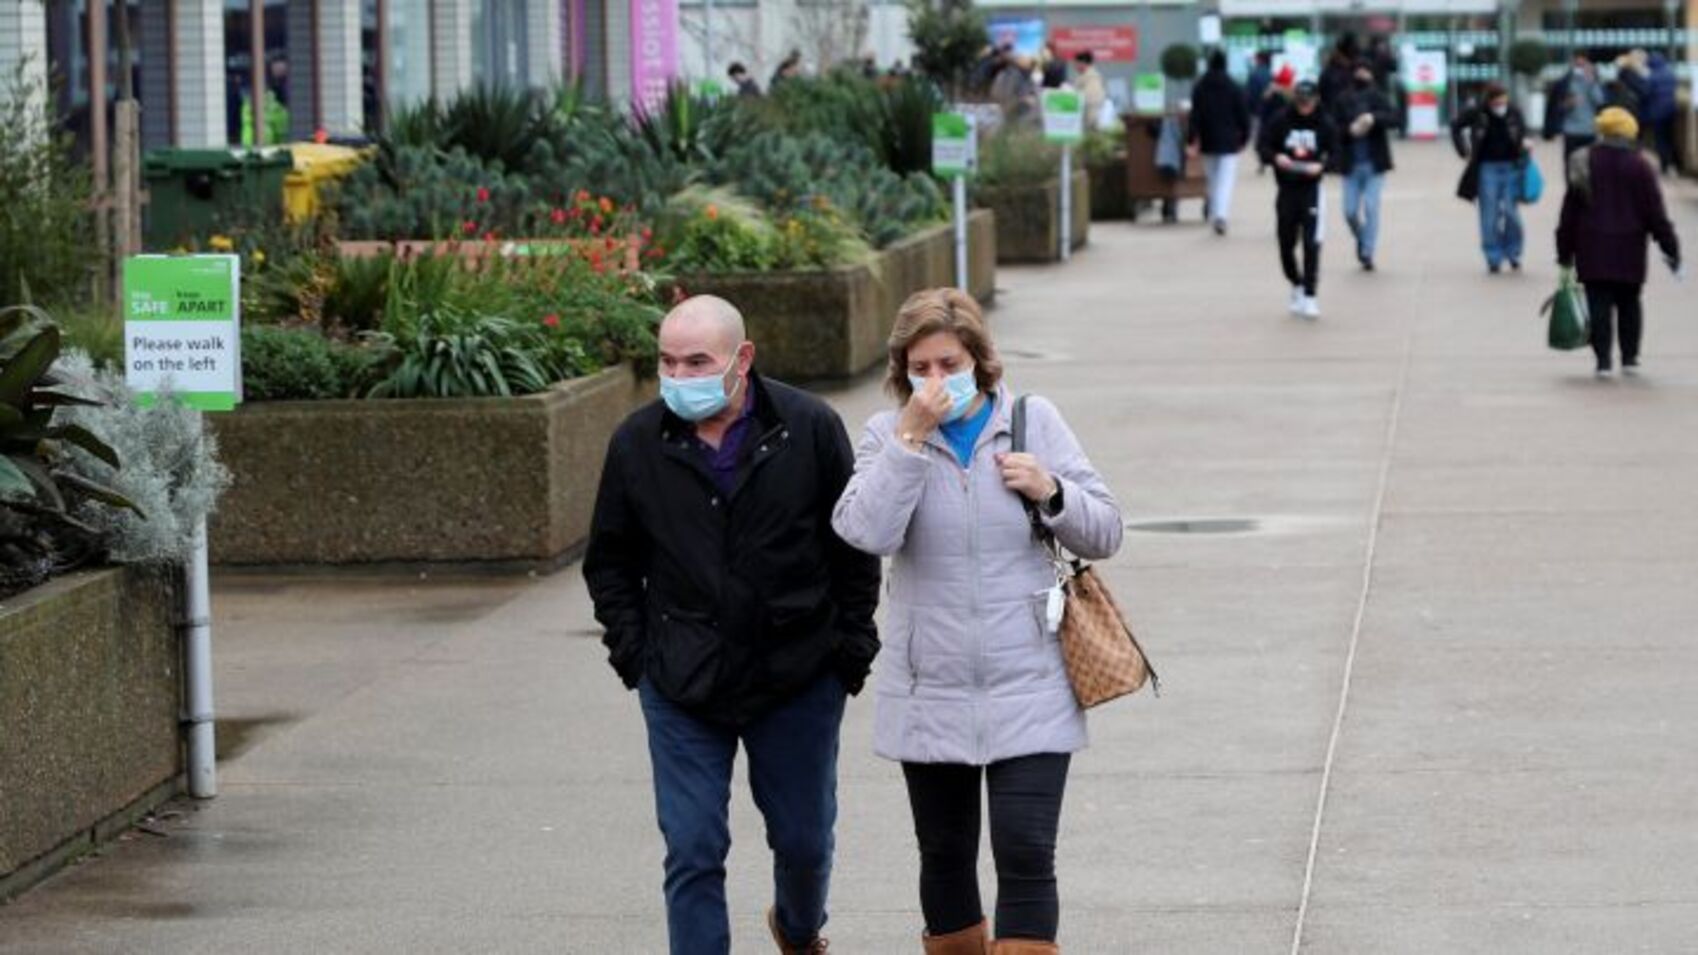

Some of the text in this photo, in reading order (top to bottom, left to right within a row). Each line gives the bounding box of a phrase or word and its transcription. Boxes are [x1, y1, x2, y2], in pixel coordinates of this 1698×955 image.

[132, 301, 168, 314] SAFE
[176, 301, 225, 313] APART
[133, 337, 225, 350] Please walk
[133, 357, 216, 371] on the left
